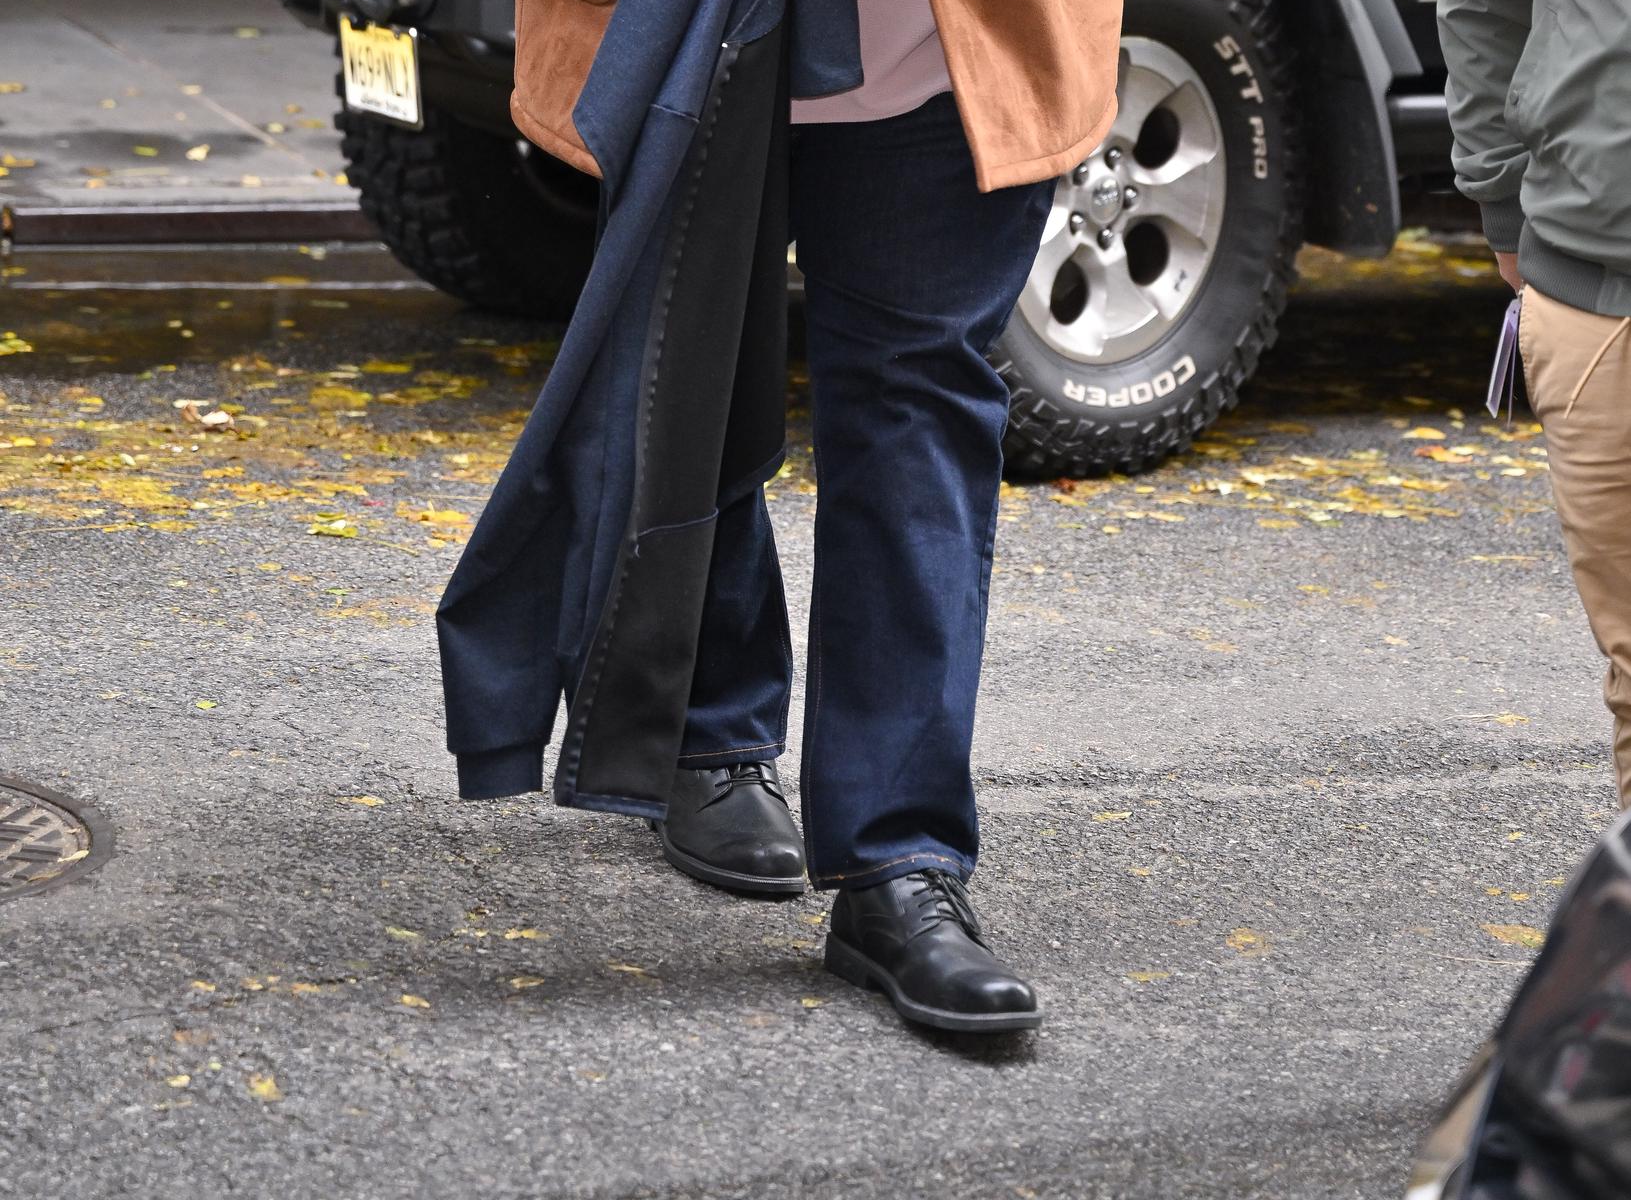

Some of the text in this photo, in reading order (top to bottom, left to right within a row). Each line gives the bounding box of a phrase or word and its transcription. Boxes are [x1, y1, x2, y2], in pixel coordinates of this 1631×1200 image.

[1213, 35, 1268, 179] STT PRO
[1062, 355, 1196, 408] COOPER
